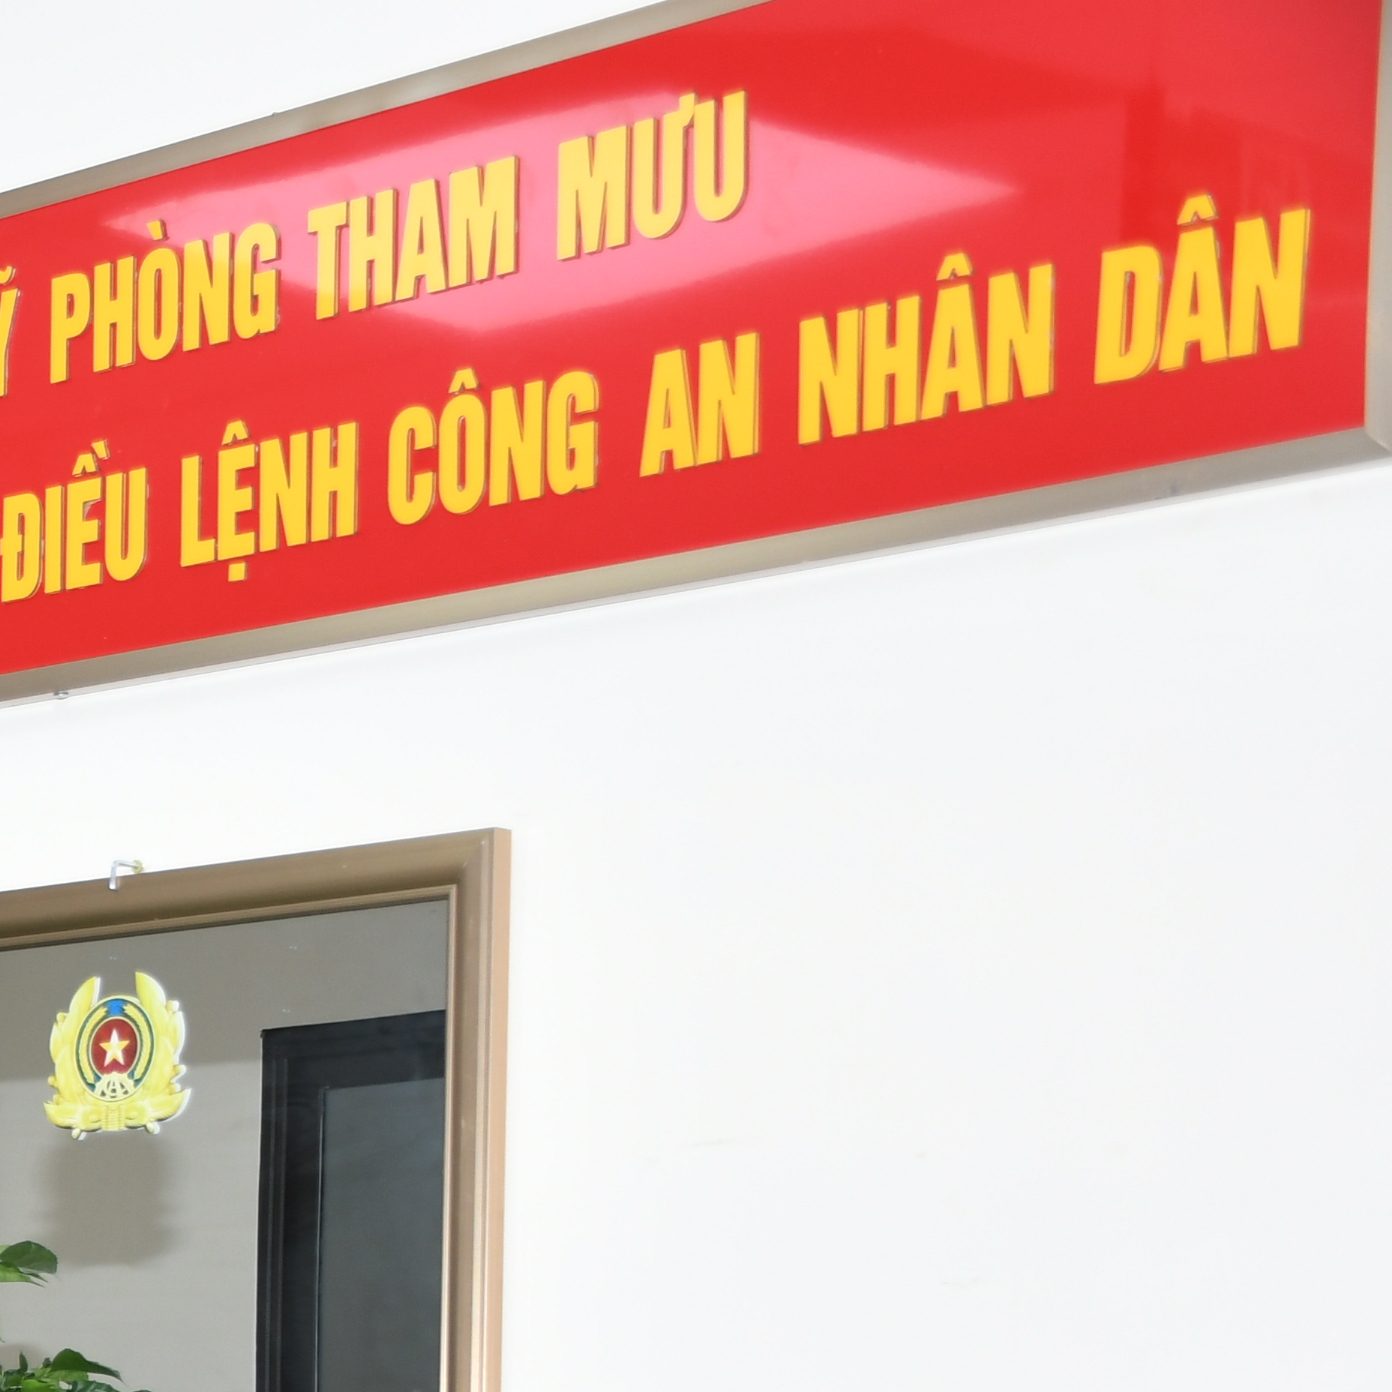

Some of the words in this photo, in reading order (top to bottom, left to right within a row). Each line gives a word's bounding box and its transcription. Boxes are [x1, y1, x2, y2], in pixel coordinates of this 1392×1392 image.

[0, 439, 148, 603] ĐIỀU
[180, 419, 360, 582] LỆNH
[387, 367, 600, 525] CÔNG
[640, 331, 761, 478] AN
[798, 251, 1055, 445] NHÂN
[1094, 192, 1312, 385] DÂN
[50, 219, 280, 384] PHÒNG
[307, 156, 518, 320] THAM
[557, 90, 748, 261] MƯU
